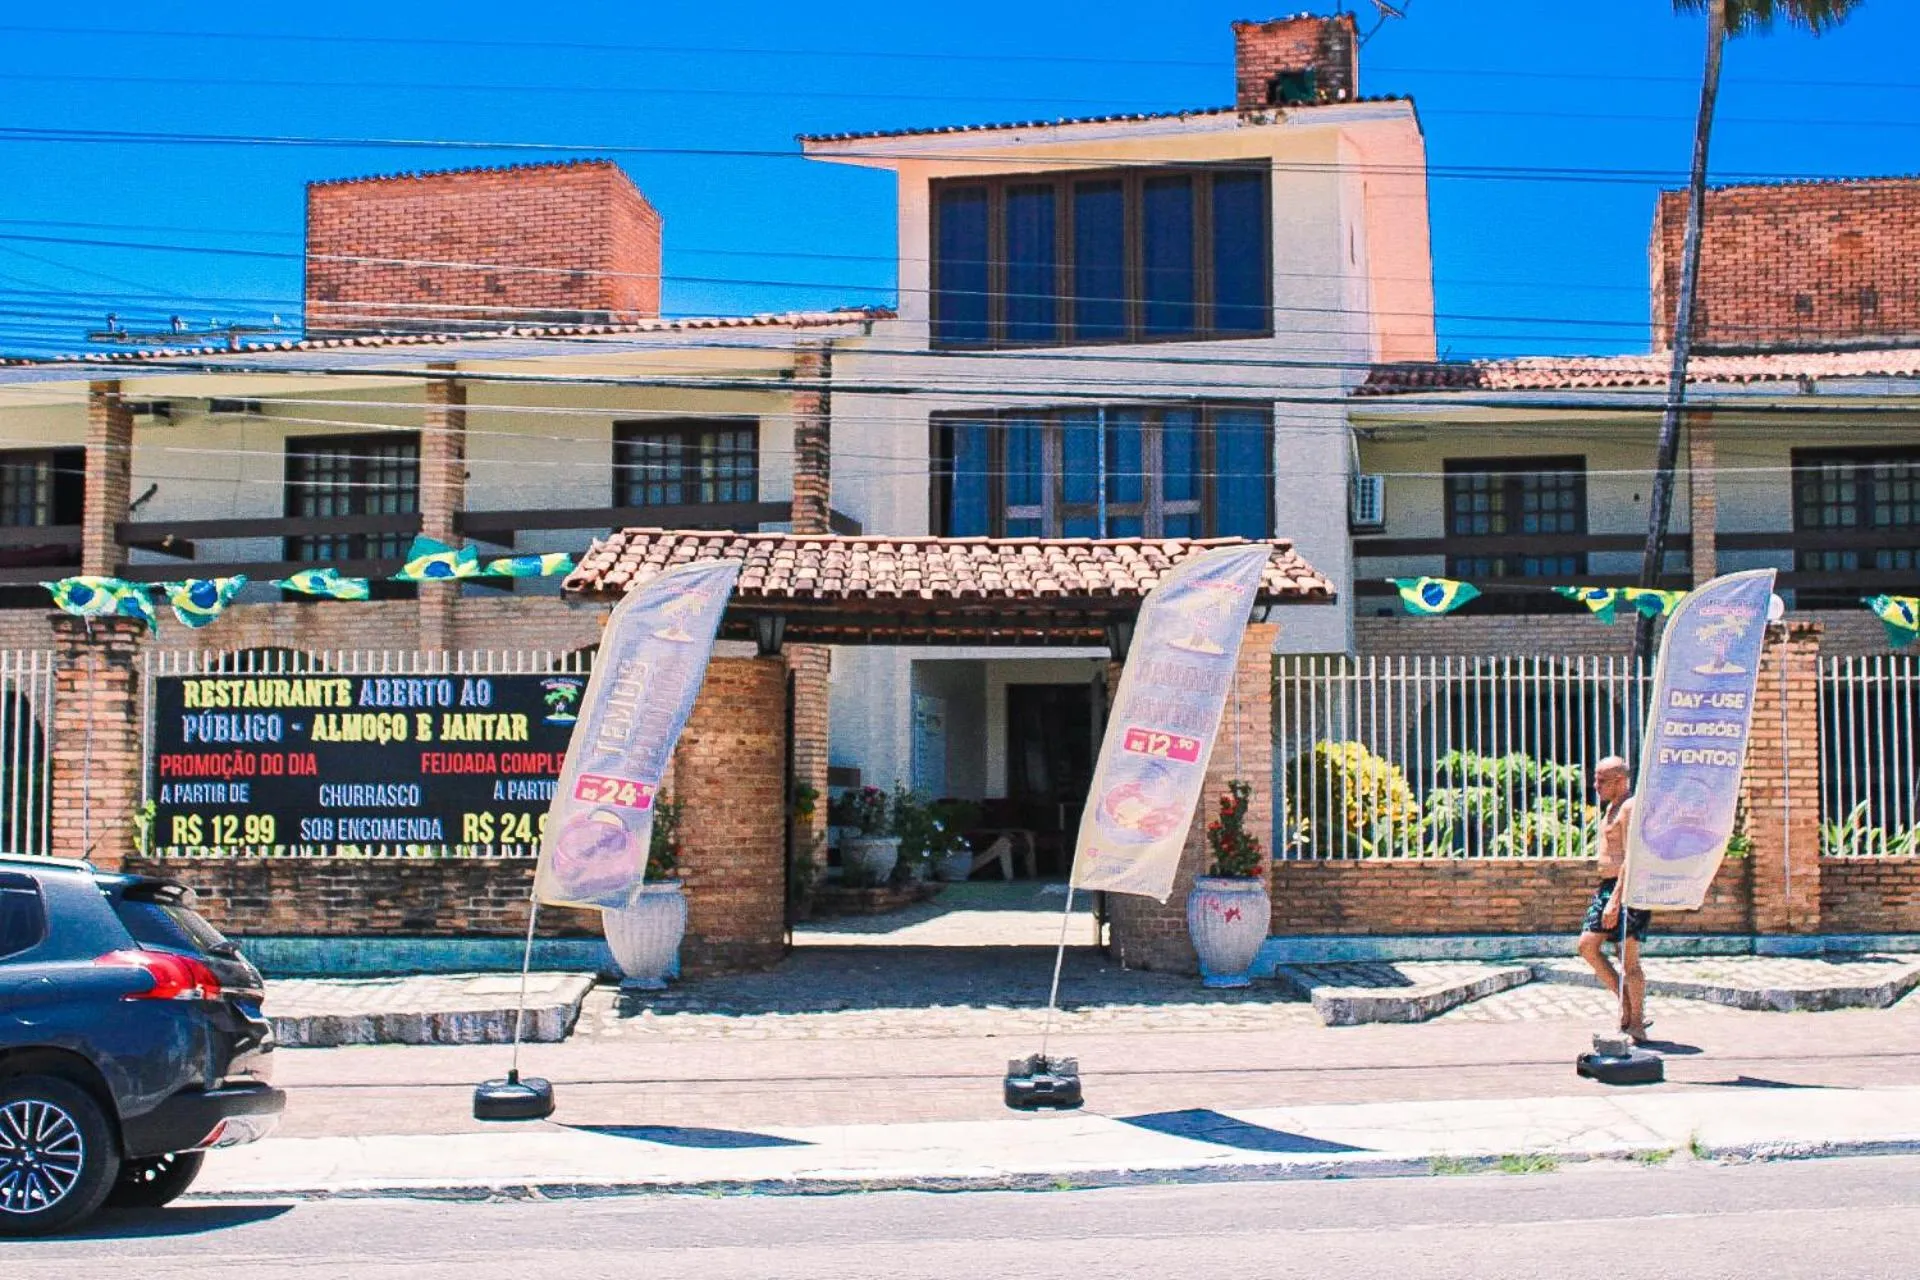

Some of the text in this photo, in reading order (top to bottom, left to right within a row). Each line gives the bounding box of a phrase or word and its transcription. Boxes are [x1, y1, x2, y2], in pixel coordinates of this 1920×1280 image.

[182, 678, 492, 708] RESTAURANTE ABERTO AO
[1671, 690, 1747, 709] DAY-USE
[182, 709, 529, 746] PÚBLICO - ALMOÇO E JANTAR
[160, 749, 318, 779] PROMOÇÃO DO DIA
[421, 752, 497, 774] FEIJOADA
[1659, 747, 1738, 767] EVENTOS
[160, 782, 249, 803] A PARTIR DE
[319, 784, 421, 807] CHURRASCO
[493, 780, 505, 800] A
[172, 812, 276, 847] R$ 12,99
[300, 817, 443, 841] SOB ENCOMENDA
[463, 811, 495, 844] R$
